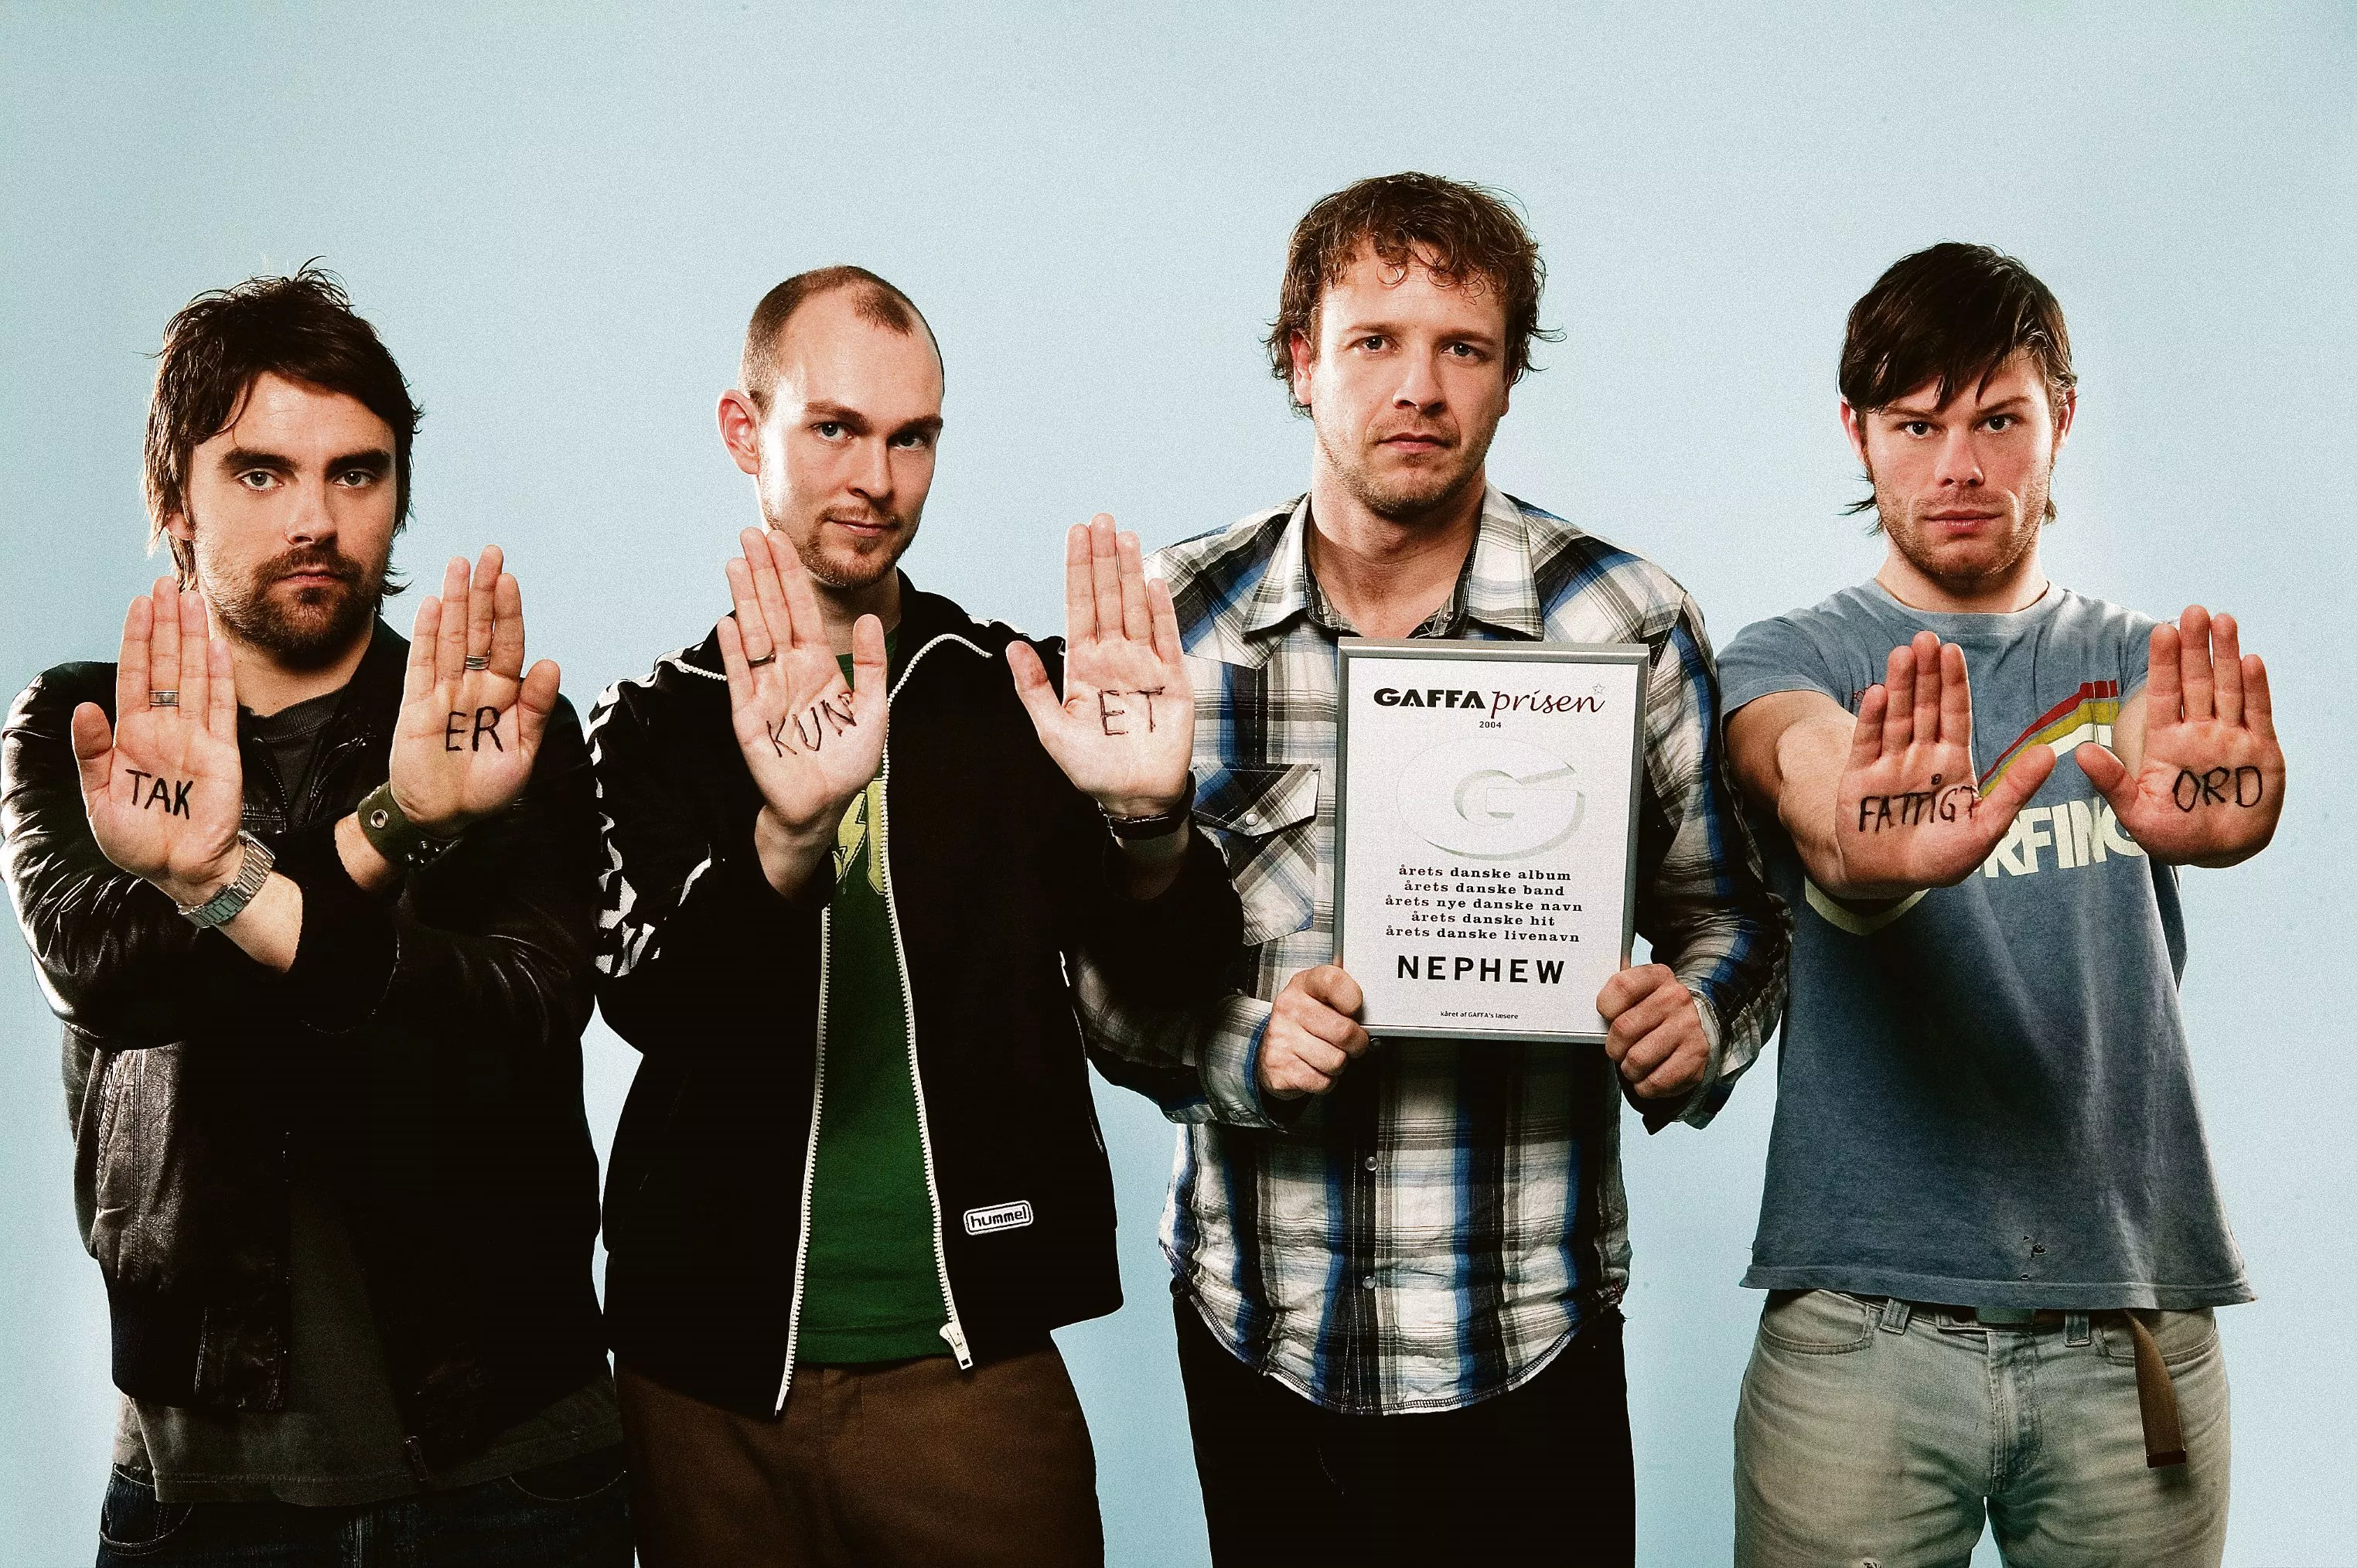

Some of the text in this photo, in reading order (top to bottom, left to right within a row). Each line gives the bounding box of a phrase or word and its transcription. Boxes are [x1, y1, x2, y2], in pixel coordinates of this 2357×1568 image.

[1097, 686, 1165, 736] ET
[1373, 687, 1606, 719] GAFFA prisen
[445, 705, 504, 753] ER
[766, 693, 857, 758] KUN
[1479, 721, 1503, 729] 2004
[125, 768, 195, 821] TAK
[2172, 765, 2263, 812] ORD
[1975, 796, 2148, 878] RFING
[1399, 864, 1571, 881] årets danske album
[1404, 880, 1565, 896] årets danske band
[1385, 895, 1583, 912] årets nye danske navn
[1411, 911, 1555, 926] årets danske hit
[1386, 925, 1580, 943] årets danske livenavn
[1397, 955, 1565, 984] NEPHEW
[1468, 1011, 1494, 1019] GAFFA's
[970, 1206, 1027, 1228] hummel
